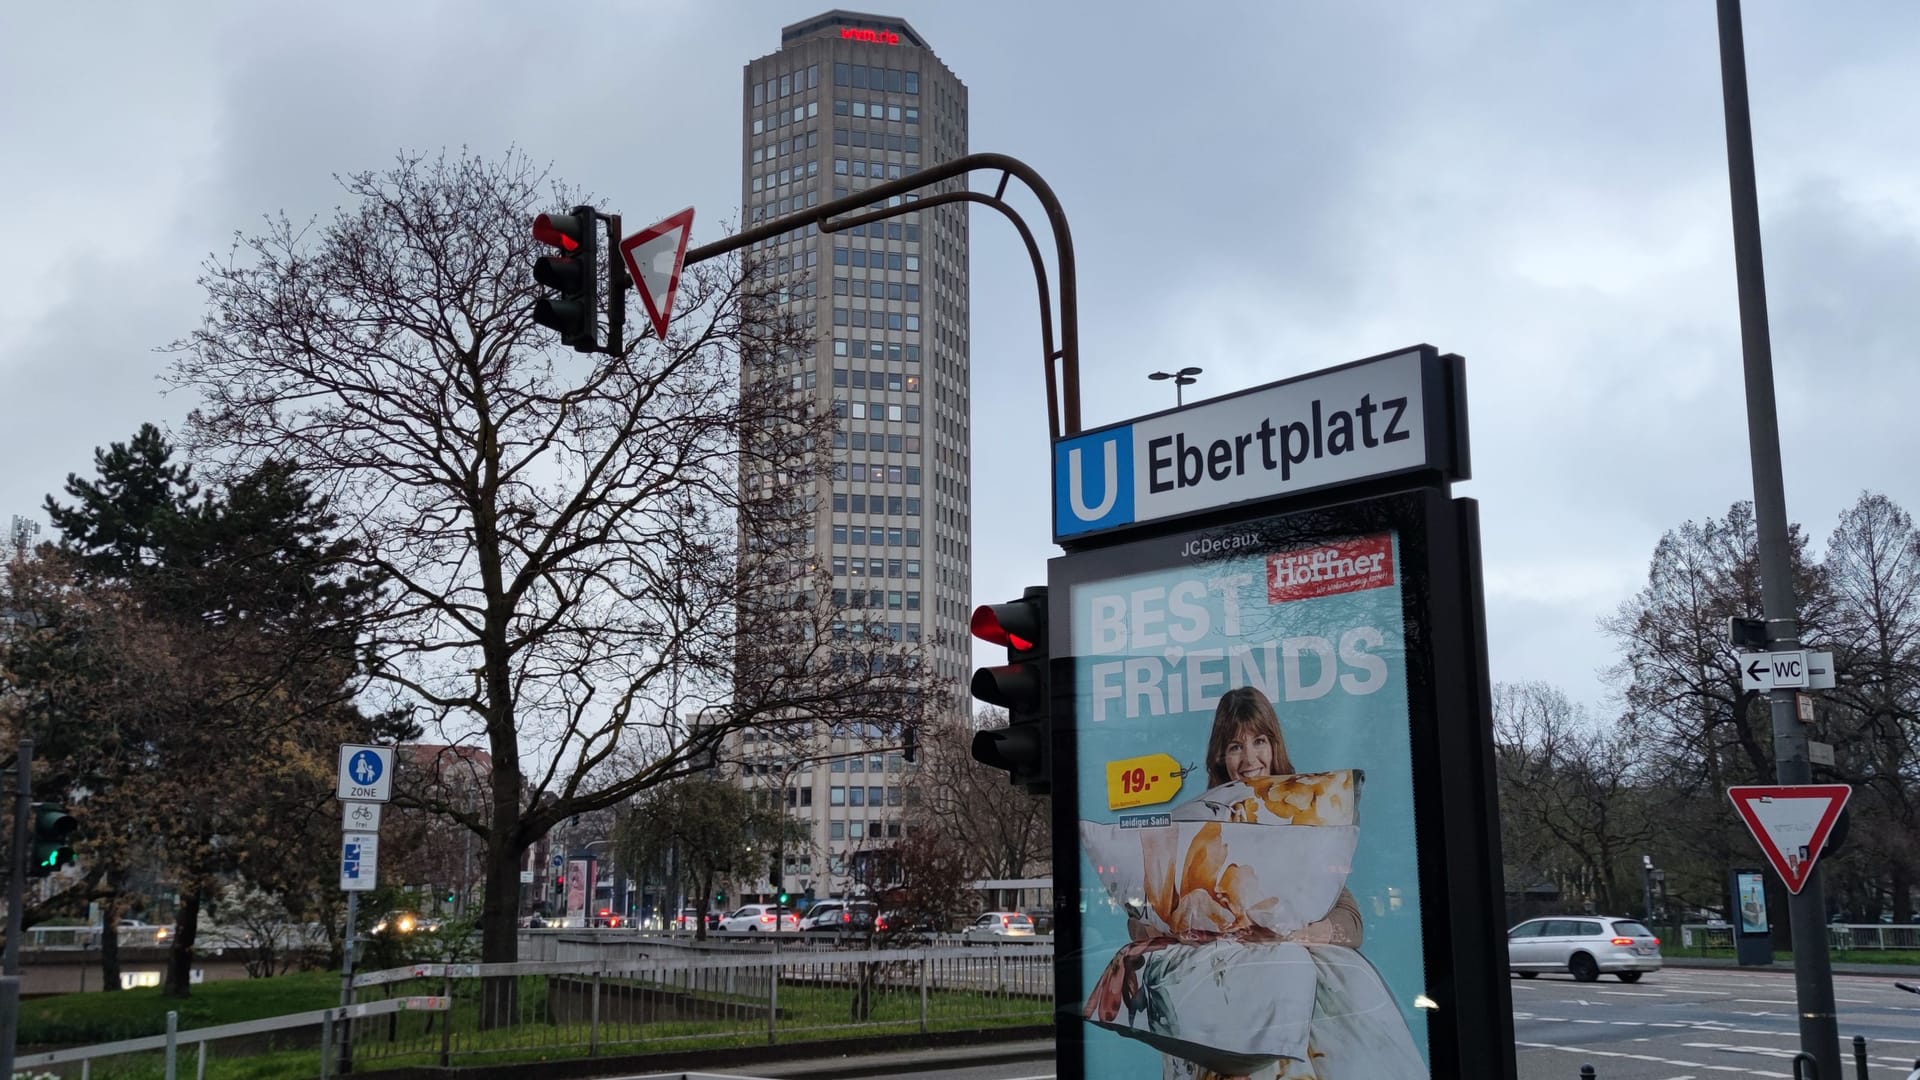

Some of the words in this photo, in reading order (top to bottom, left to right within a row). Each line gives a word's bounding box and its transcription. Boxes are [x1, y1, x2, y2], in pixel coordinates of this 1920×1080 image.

[1068, 439, 1118, 521] U
[1148, 393, 1410, 494] Ebertplatz
[1181, 533, 1260, 557] JCDecaux
[1272, 549, 1385, 588] Höffner
[1091, 573, 1252, 656] BEST
[1773, 660, 1801, 678] WC
[350, 786, 377, 798] ZONE
[1121, 767, 1159, 794] 19.-
[355, 821, 367, 829] frei
[1150, 816, 1170, 826] Satin
